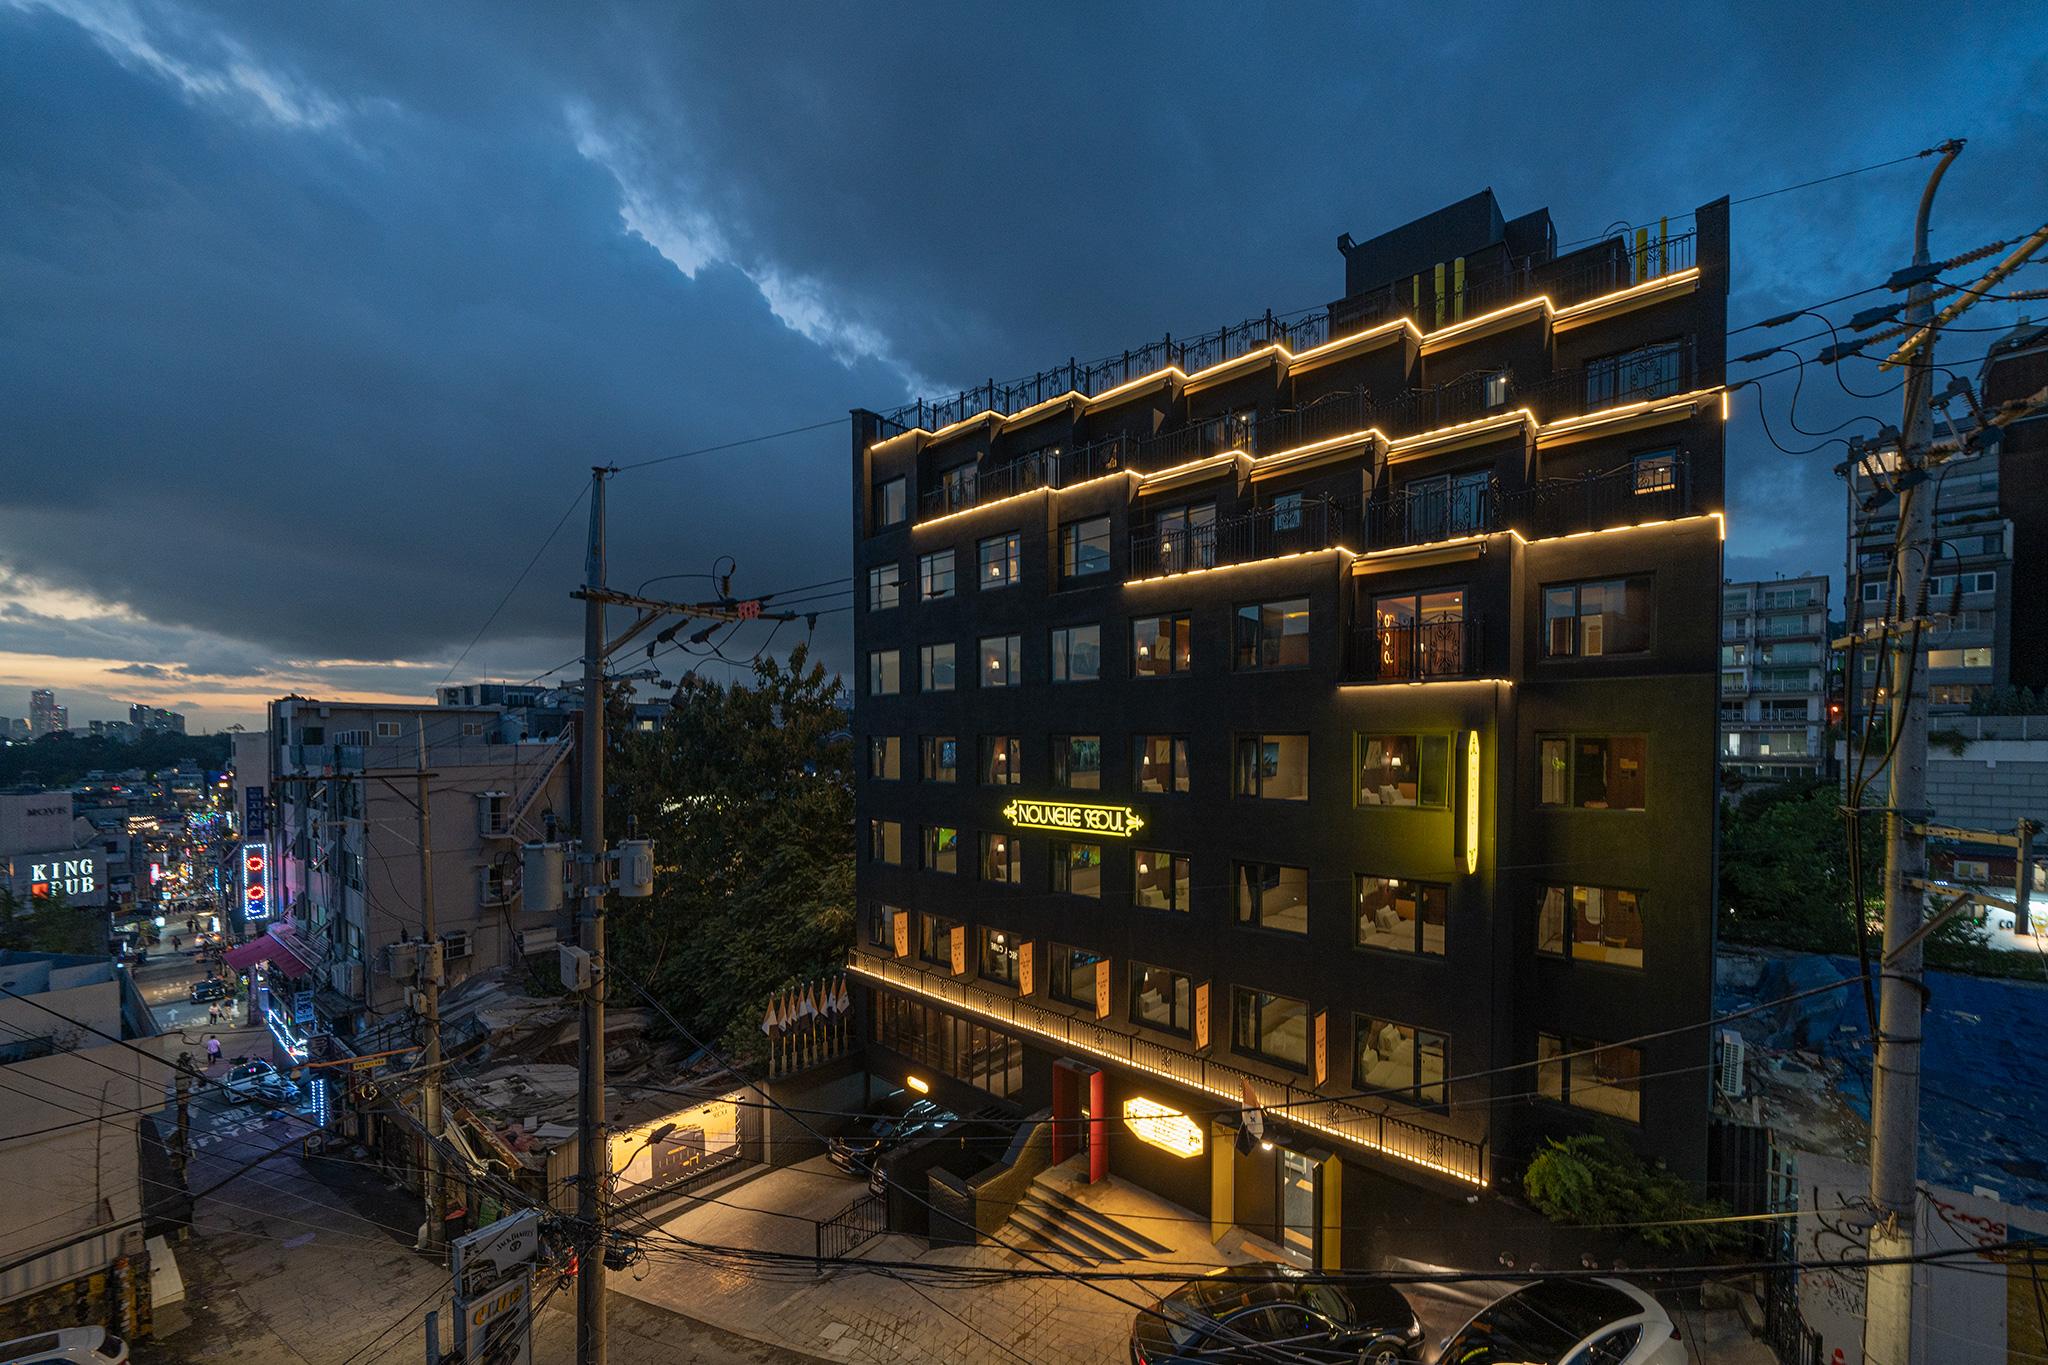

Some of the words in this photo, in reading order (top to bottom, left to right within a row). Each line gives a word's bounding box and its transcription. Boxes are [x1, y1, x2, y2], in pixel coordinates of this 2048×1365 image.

[1018, 804, 1081, 828] NOUVELLE
[1084, 808, 1124, 832] SEOUL
[31, 859, 94, 881] KING
[50, 877, 94, 897] PUB
